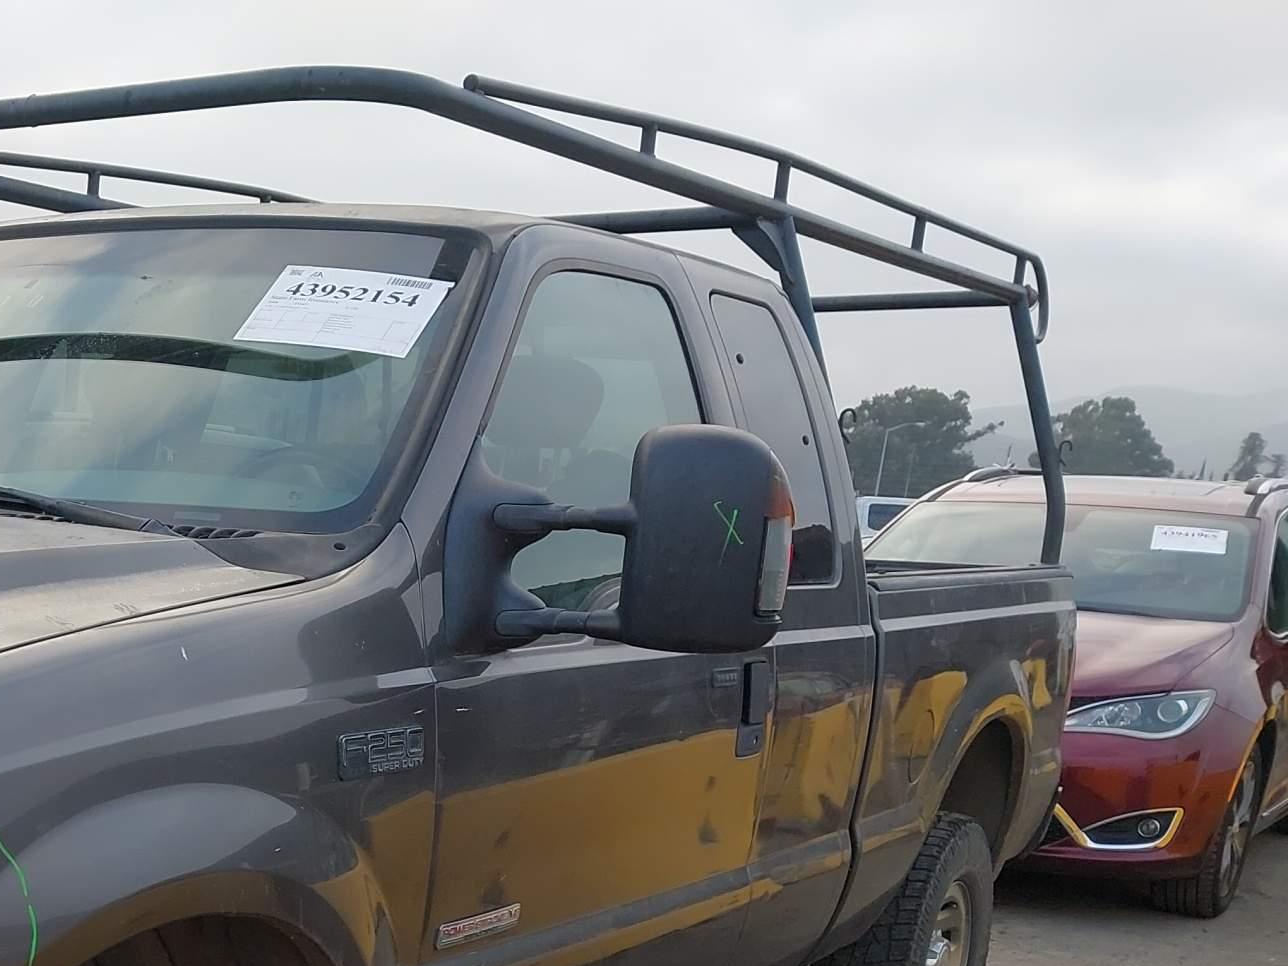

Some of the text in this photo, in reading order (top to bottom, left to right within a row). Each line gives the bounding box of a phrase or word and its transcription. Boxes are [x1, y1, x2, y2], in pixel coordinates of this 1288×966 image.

[286, 281, 420, 307] 43952154
[342, 727, 425, 767] F-250
[370, 758, 425, 773] SUPER DUTY
